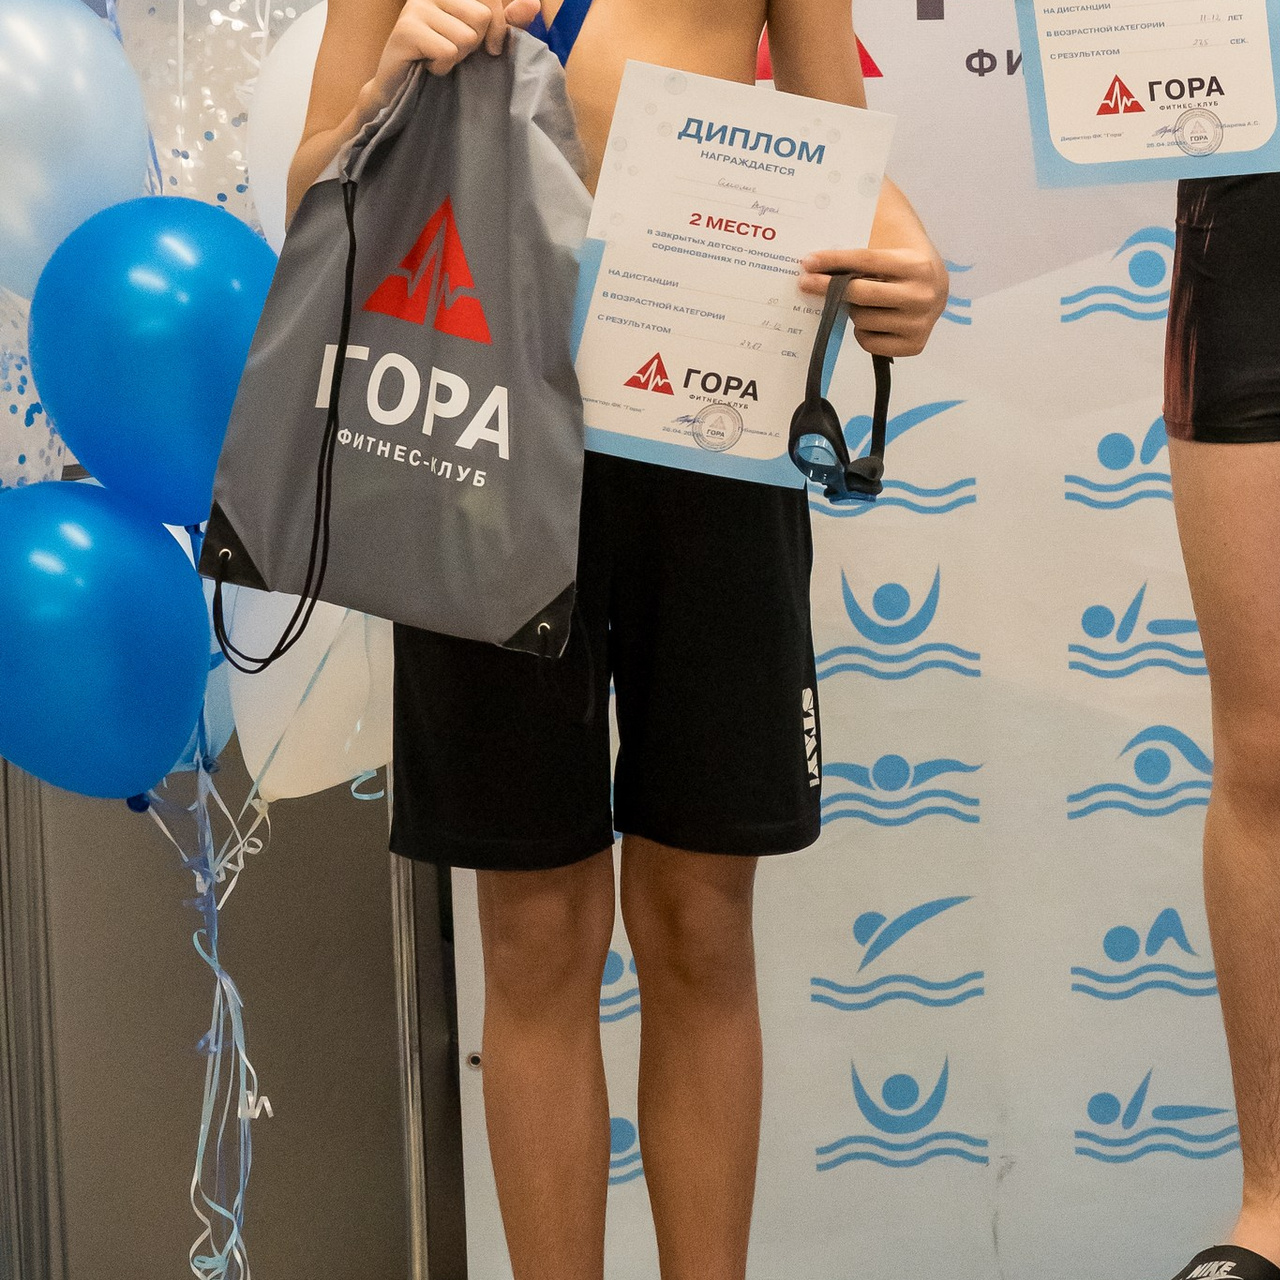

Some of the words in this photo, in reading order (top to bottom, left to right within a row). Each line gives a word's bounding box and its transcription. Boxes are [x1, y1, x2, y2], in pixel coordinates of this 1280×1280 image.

[1043, 7, 1055, 15] НА
[1056, 3, 1111, 14] ДИСТАНЦИИ
[1053, 26, 1112, 37] ВОЗРАСТНОЙ
[1114, 21, 1165, 31] КАТЕГОРИИ
[1057, 48, 1120, 59] РЕЗУЛЬТАТОМ
[1148, 75, 1225, 102] ГОРА
[1159, 101, 1219, 111] ФИТНЕС-КЛУБ
[677, 117, 825, 165] ДИПЛОМ
[1190, 134, 1208, 142] ГОРА
[700, 150, 795, 177] НАГРАЖДАЕТСЯ
[689, 213, 702, 226] 2
[705, 215, 777, 241] МЕСТО
[655, 230, 706, 245] закрытых
[652, 243, 732, 263] соревнованиях
[734, 258, 747, 266] по
[748, 261, 800, 277] плаванию
[622, 271, 679, 288] ДИСТАНЦИИ
[610, 293, 671, 310] ВОЗРАСТНОЙ
[673, 305, 726, 321] КАТЕГОРИИ
[606, 315, 671, 334] РЕЗУЛЬТАТОМ
[787, 327, 803, 335] ЛЕТ
[683, 368, 759, 401] ГОРА
[315, 344, 509, 460] ГОРА
[689, 394, 749, 409] ФИТНЕС-КЛУБ
[706, 428, 725, 438] ГОРА
[337, 428, 487, 487] ФИТНЕС-КЛУБ
[1186, 1261, 1237, 1279] NIKE
